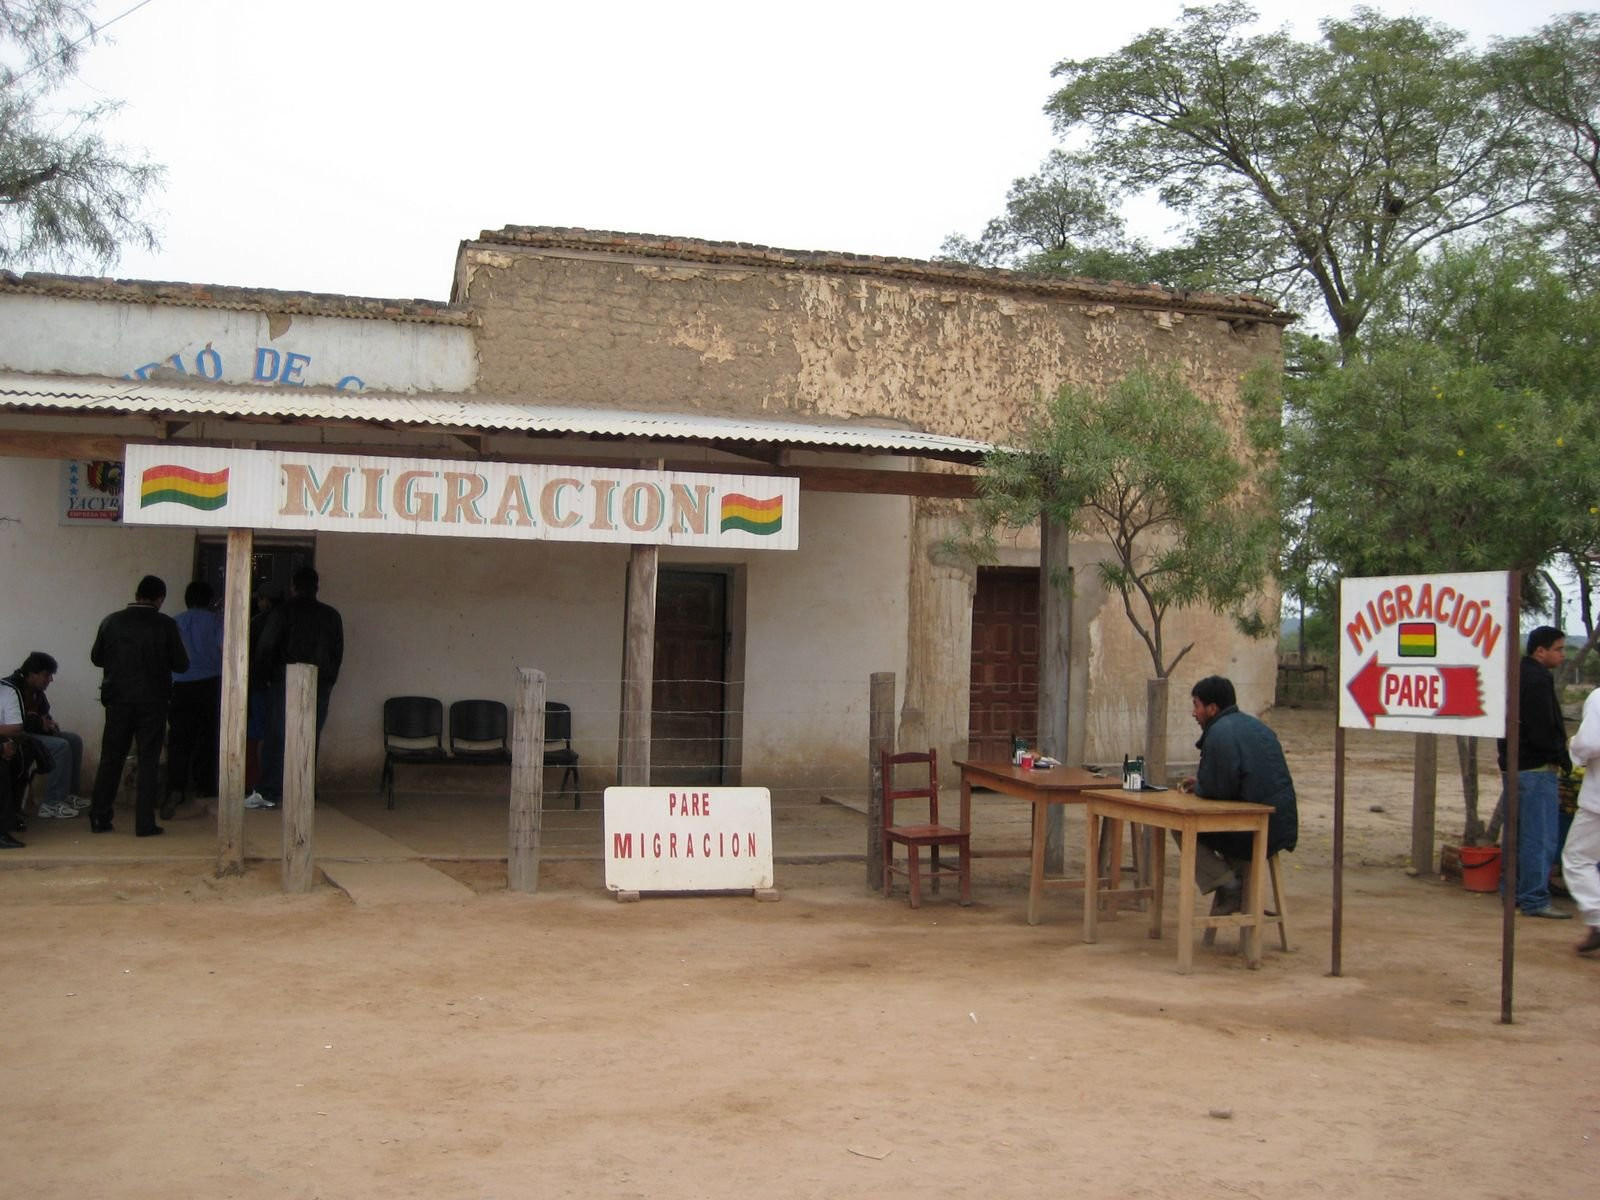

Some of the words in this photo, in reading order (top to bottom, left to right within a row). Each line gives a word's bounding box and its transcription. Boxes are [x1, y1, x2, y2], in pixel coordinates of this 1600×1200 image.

[253, 347, 311, 387] DE
[278, 464, 716, 535] MIGRACION
[1384, 674, 1441, 709] PARE
[669, 793, 710, 816] PARE
[613, 832, 757, 859] MIGRACION
